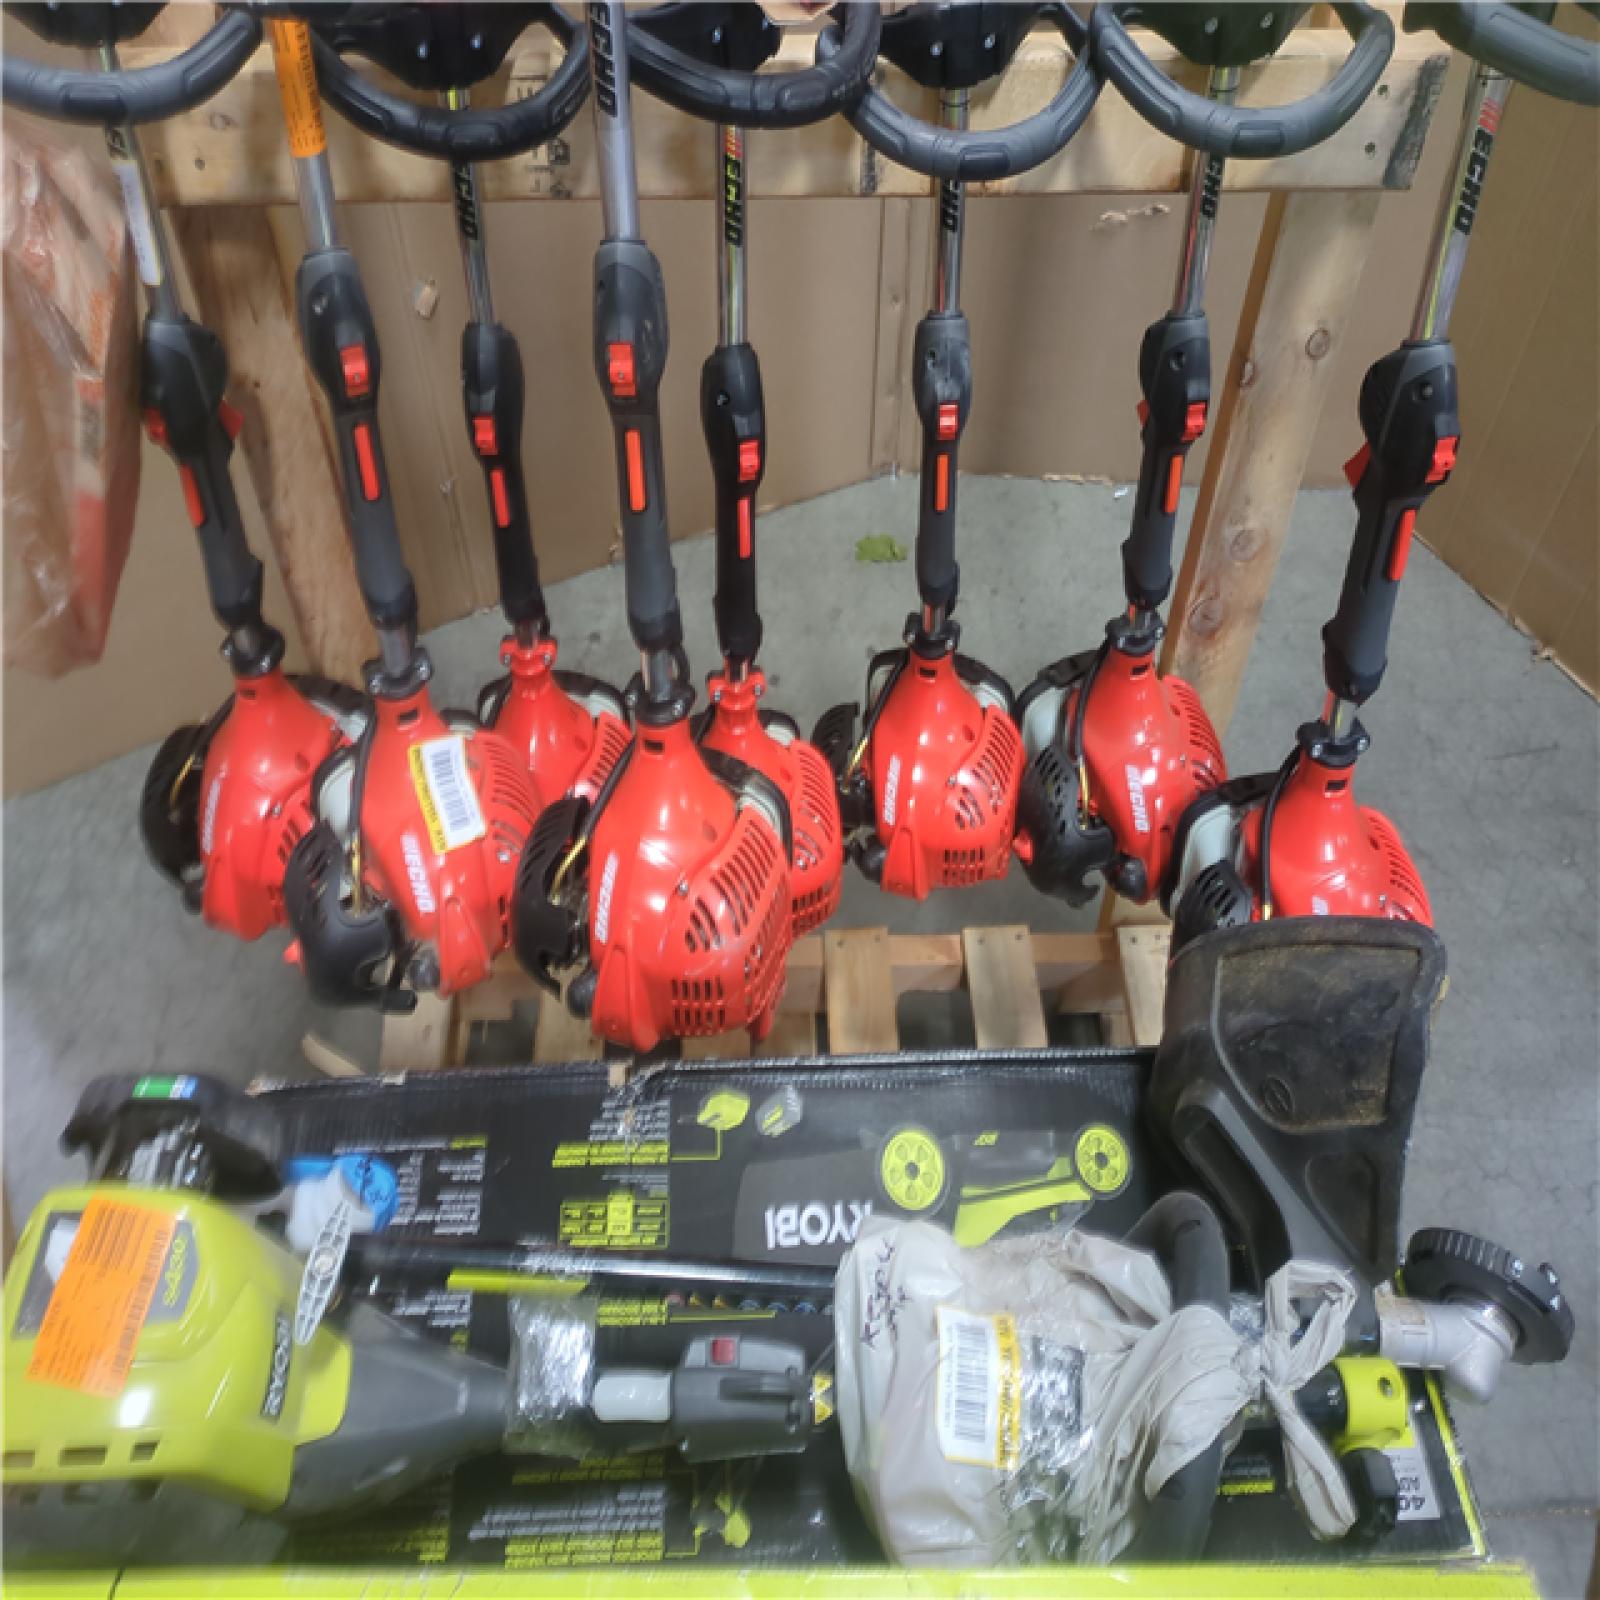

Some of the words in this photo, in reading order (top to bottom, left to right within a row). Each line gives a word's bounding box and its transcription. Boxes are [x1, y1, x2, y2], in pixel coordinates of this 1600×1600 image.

[591, 3, 618, 117] ECHO
[725, 155, 742, 247] ECHO
[1455, 127, 1494, 235] ECHO
[1128, 781, 1151, 833] ECHO
[406, 854, 437, 913] ECHO
